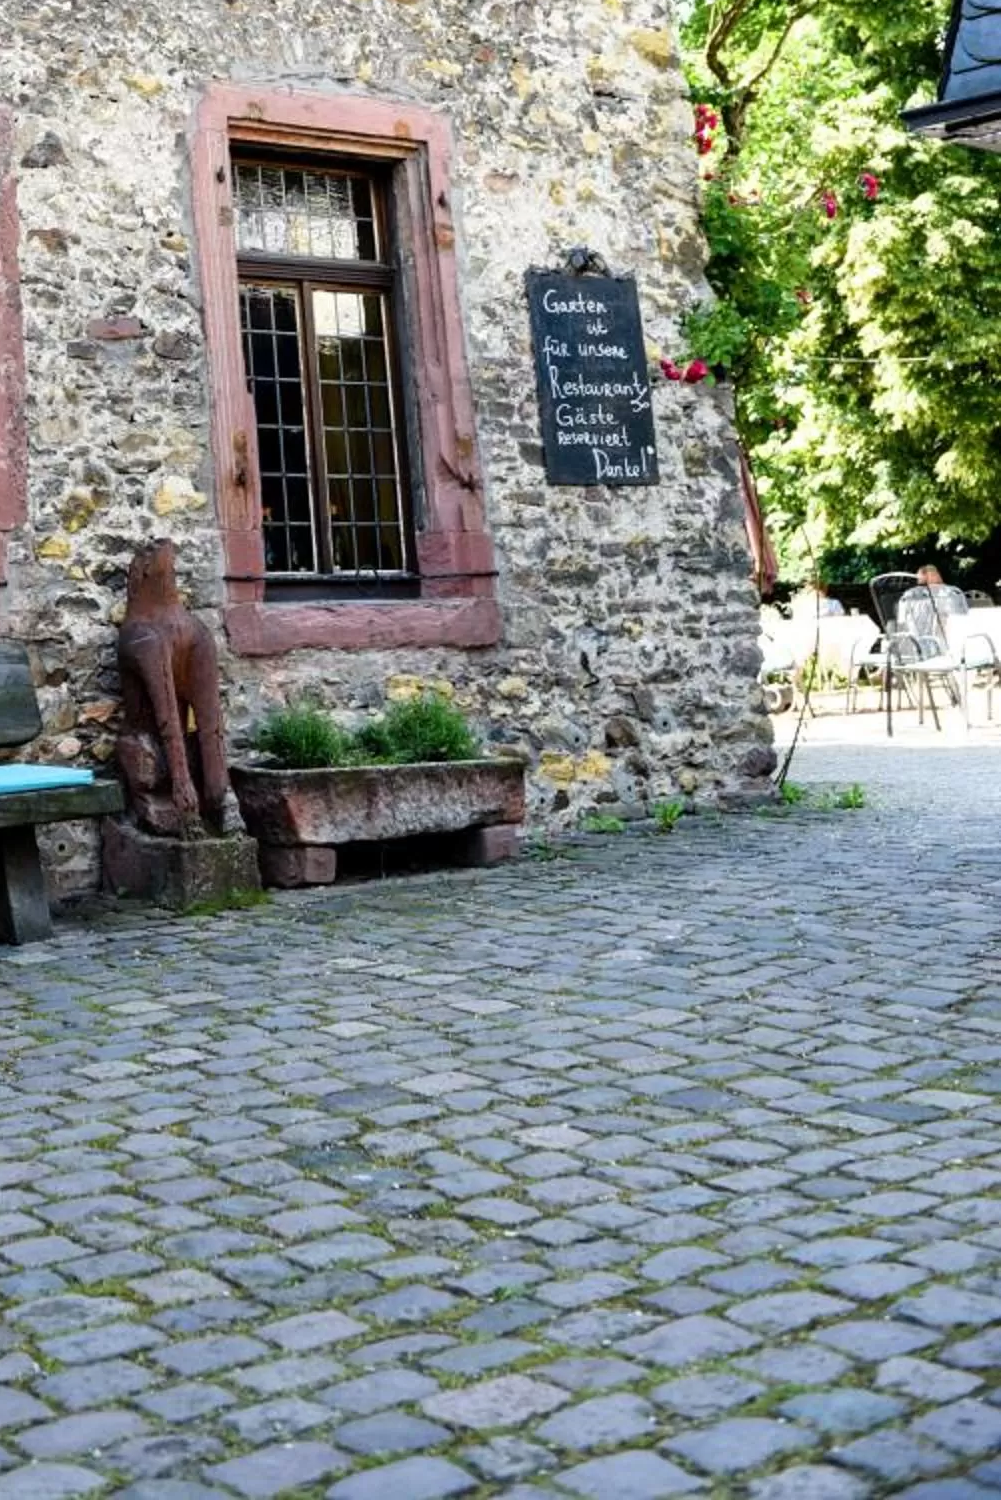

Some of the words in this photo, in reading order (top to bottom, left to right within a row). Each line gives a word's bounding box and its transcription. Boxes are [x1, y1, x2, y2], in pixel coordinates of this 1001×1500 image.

[543, 288, 608, 314] Garten
[542, 335, 571, 365] für
[578, 343, 629, 359] unsere
[555, 403, 620, 427] Gäste
